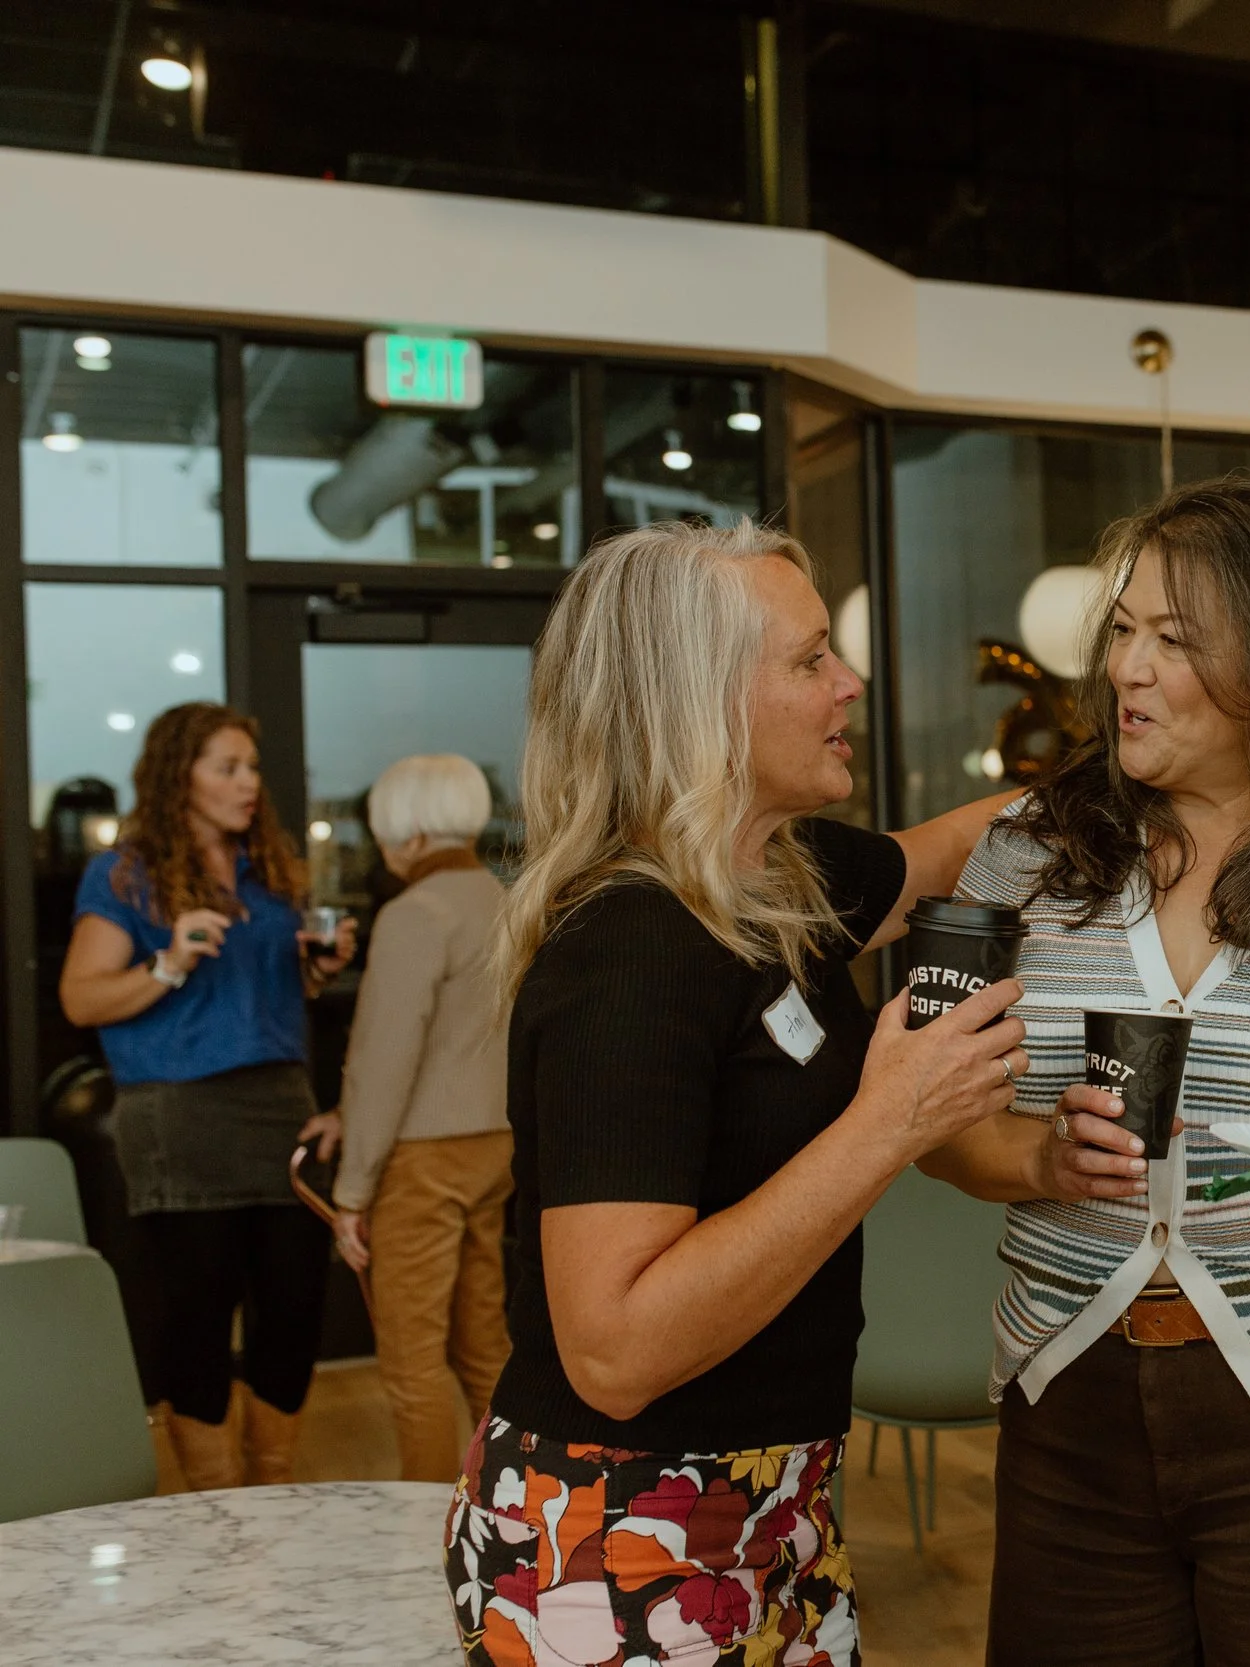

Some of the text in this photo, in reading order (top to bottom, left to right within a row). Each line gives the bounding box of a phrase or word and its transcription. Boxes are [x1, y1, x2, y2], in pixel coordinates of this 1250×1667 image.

[386, 335, 469, 403] EXIT
[909, 966, 992, 994] DISTRIC
[910, 995, 960, 1015] COFF
